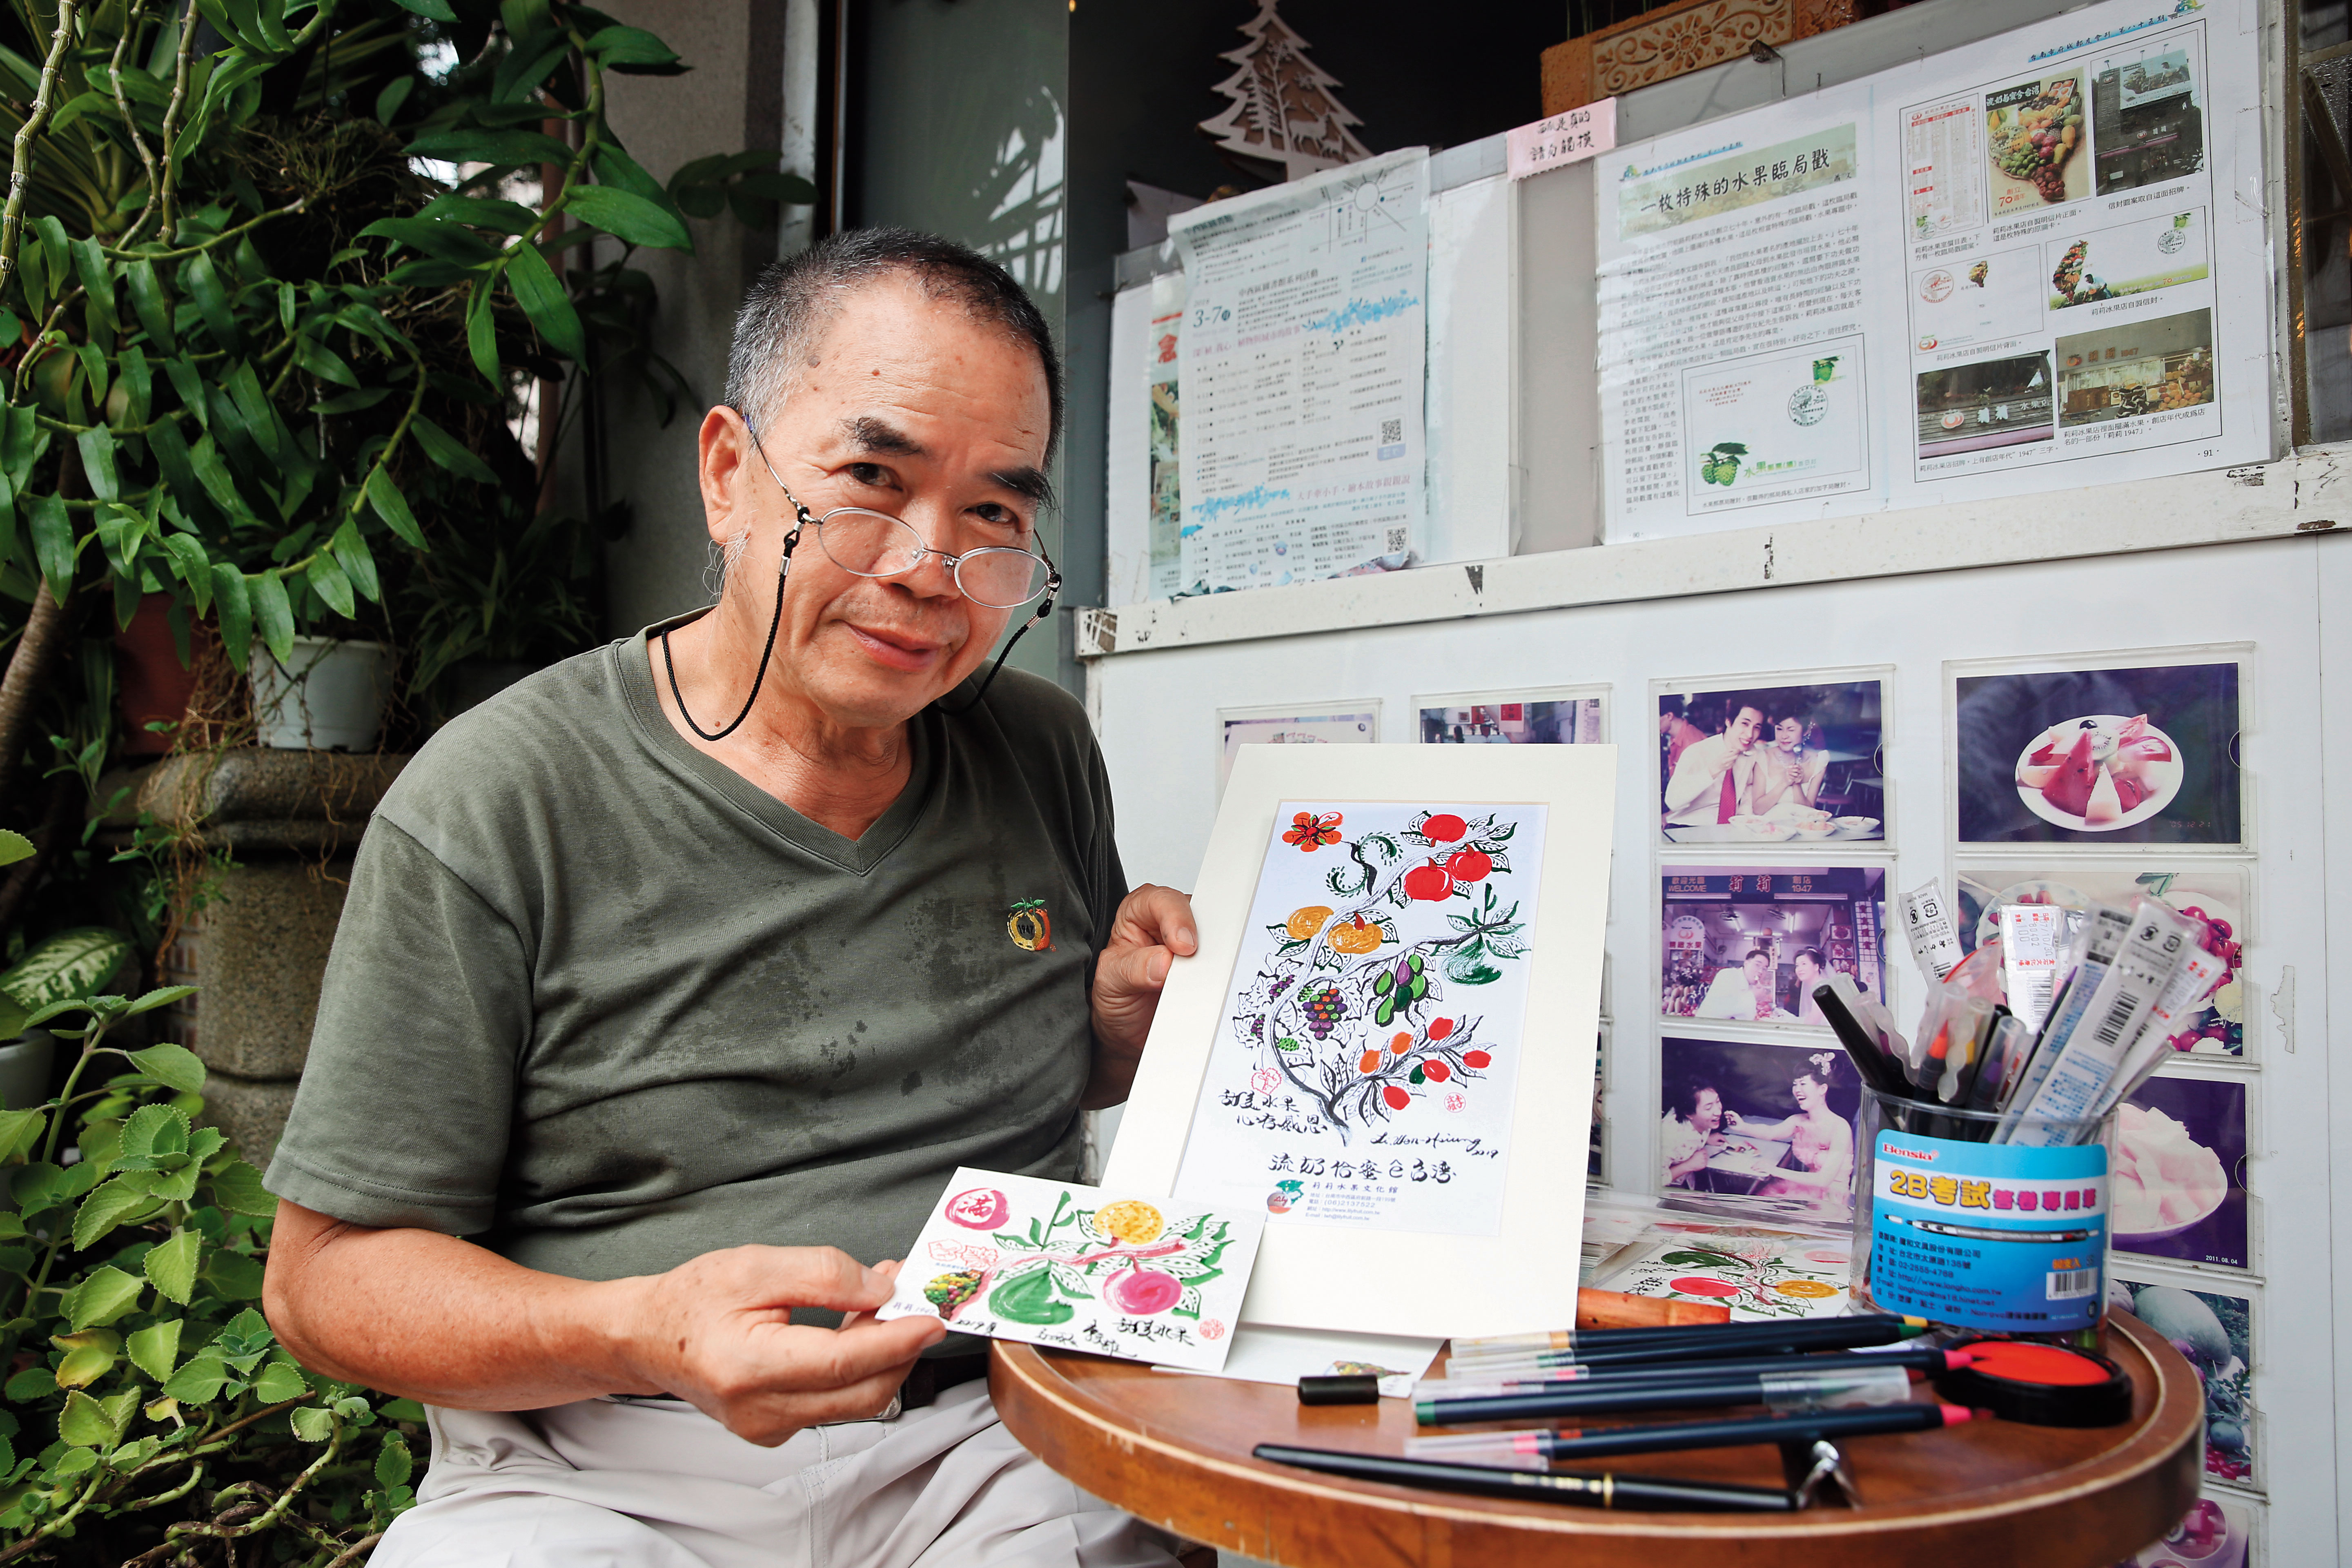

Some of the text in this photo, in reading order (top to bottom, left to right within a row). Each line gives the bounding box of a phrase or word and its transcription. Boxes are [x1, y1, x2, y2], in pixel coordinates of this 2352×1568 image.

[1640, 148, 1830, 213] 一枚特殊的水果臨局戳
[2108, 185, 2190, 210] 信封圖案取自這面招牌。
[1993, 207, 2081, 235] 莉莉冰果店自製明信片正面，
[1993, 220, 2060, 243] 這是枚特殊的原圖卡。
[2091, 297, 2163, 316] 莉莉冰果店自製信封。
[1936, 340, 2022, 361] 莉莉冰果店自製明信片背面。
[1668, 884, 1813, 893] WELCOME 1947
[2029, 923, 2039, 947] 80402
[1218, 1089, 1300, 1113] 甜美水果
[1236, 1114, 1328, 1134] 心存感恩
[1882, 1142, 1933, 1161] Bensia
[1312, 1182, 1399, 1194] 莉莉水果文化館
[1890, 1169, 1991, 1209] 2B考試
[1274, 1196, 1289, 1205] Lily
